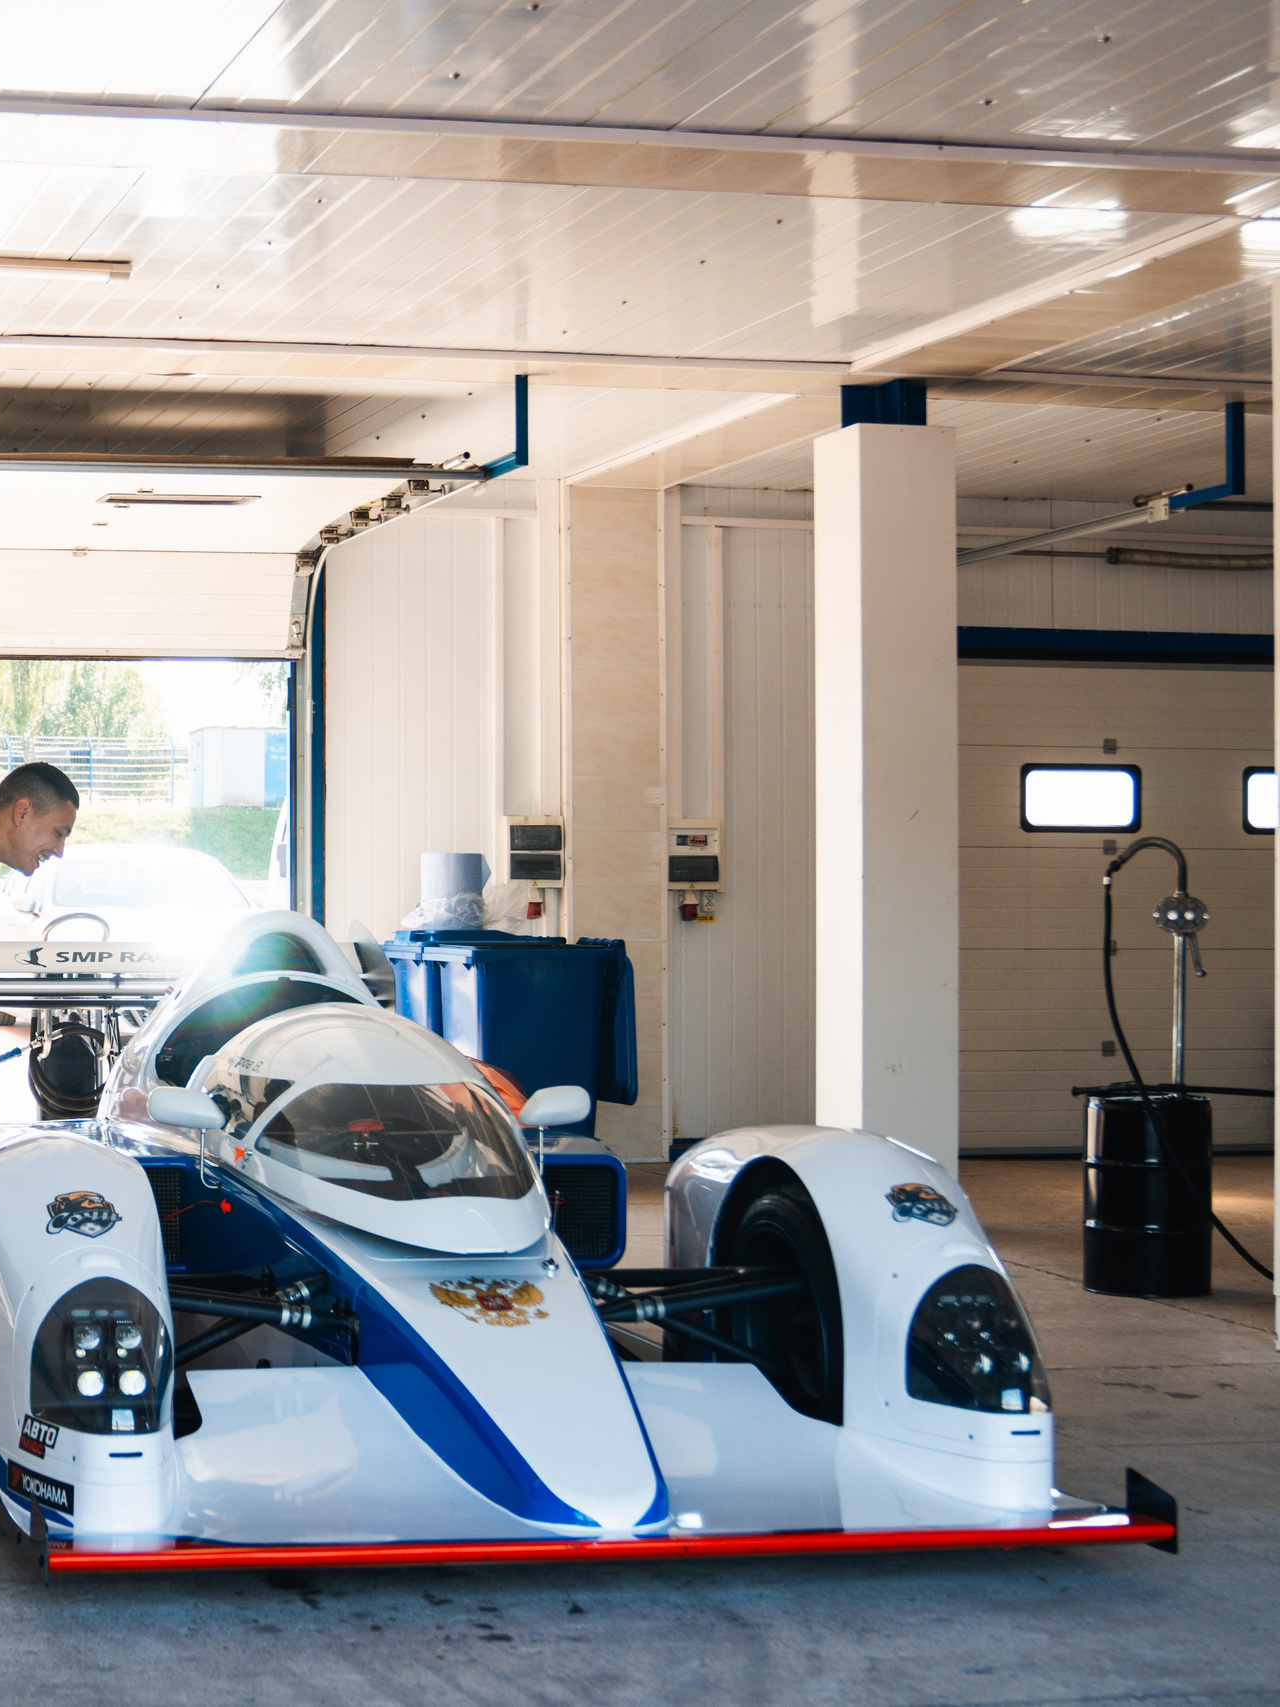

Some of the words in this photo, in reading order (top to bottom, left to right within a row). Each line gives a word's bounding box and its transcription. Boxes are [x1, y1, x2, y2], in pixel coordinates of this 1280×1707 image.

[55, 951, 114, 963] SMP
[46, 1211, 123, 1234] Сочи
[22, 1417, 57, 1446] АВТО
[21, 1473, 68, 1508] YOKOHAMA
